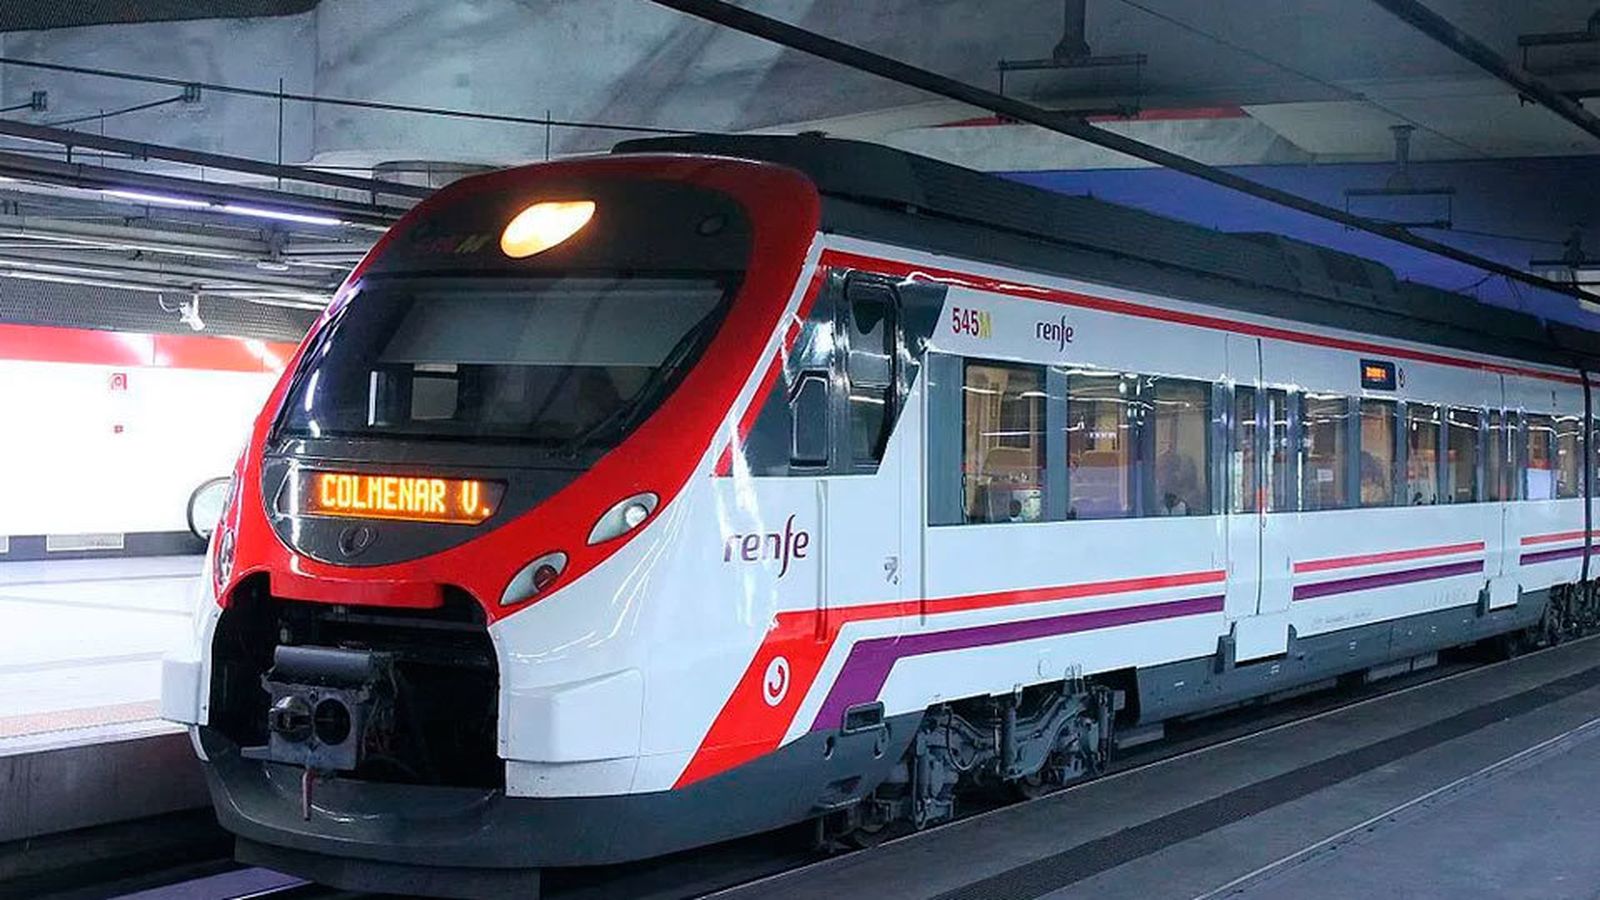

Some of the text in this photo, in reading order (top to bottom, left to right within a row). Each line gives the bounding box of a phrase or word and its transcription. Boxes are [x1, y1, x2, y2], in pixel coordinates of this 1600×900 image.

[1036, 315, 1074, 352] renfe
[321, 474, 446, 513] COLMENAR
[723, 514, 809, 578] renfe
